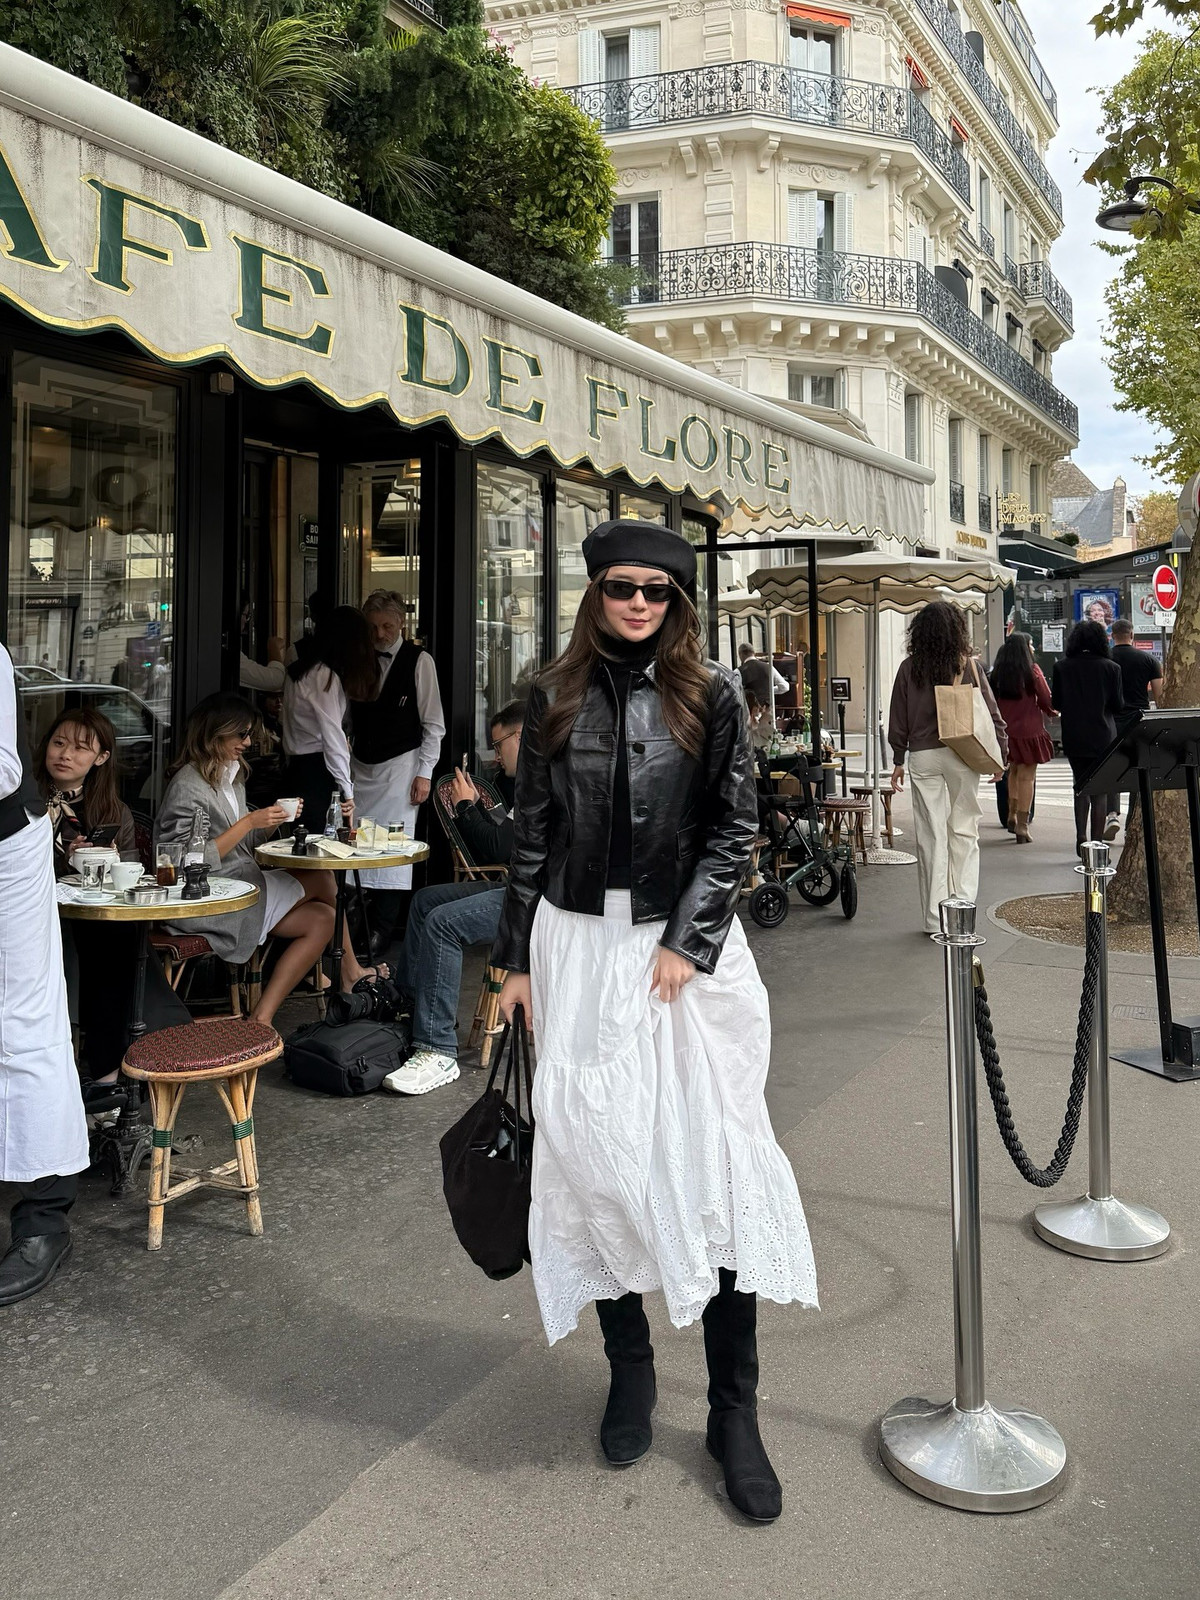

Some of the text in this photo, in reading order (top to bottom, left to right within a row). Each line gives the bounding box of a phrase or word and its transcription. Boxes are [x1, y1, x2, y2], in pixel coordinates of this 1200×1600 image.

[398, 300, 548, 426] DE
[585, 374, 793, 496] FLORE
[1000, 513, 1047, 524] MAGOTS
[1135, 555, 1149, 564] FDJ
